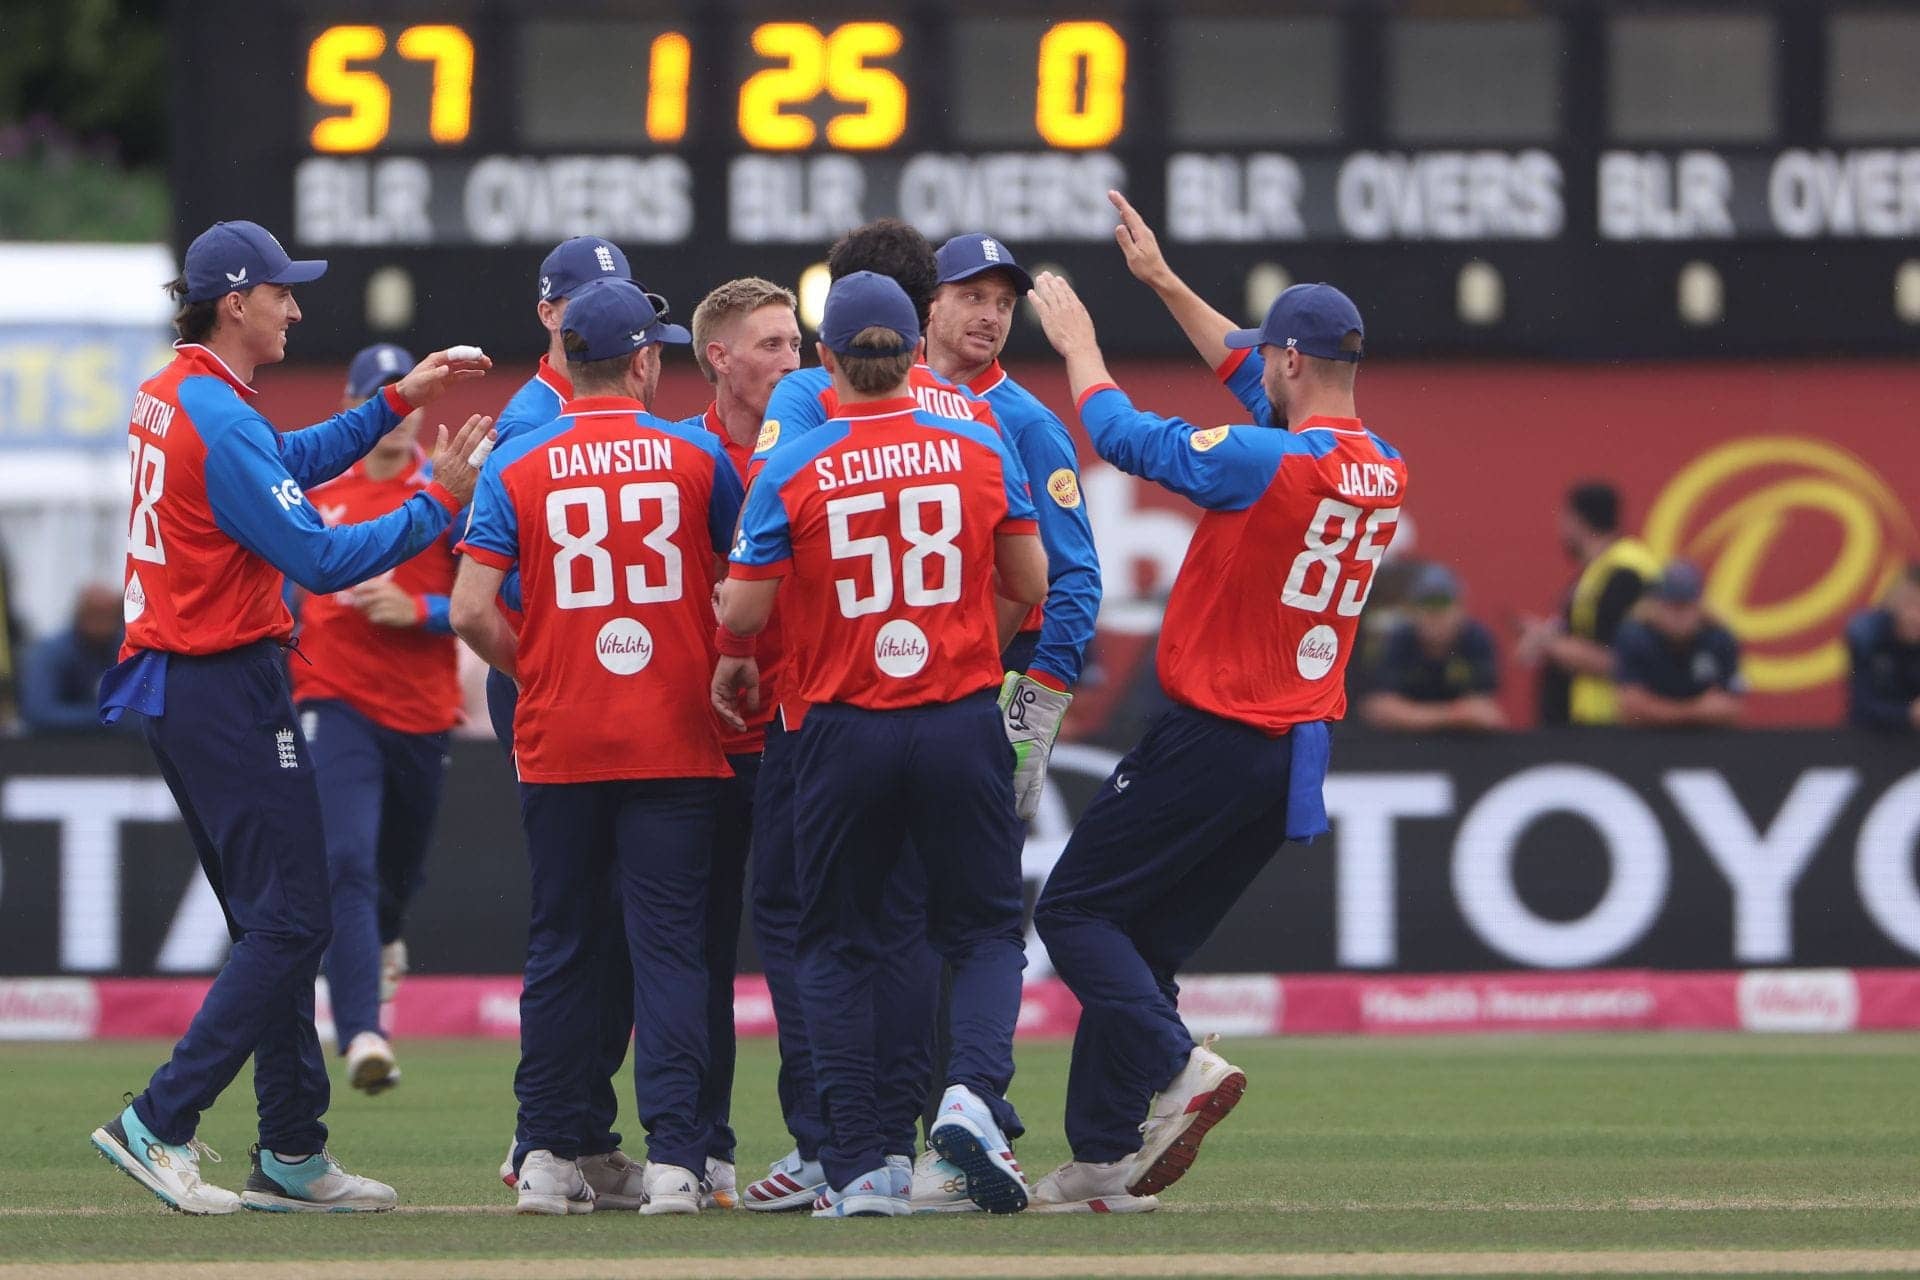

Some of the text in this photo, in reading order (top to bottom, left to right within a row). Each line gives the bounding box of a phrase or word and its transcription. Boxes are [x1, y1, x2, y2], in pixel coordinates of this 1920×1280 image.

[306, 24, 475, 152] 57
[647, 31, 692, 143] 1
[738, 21, 908, 151] 25
[1036, 21, 1127, 149] 0
[294, 153, 693, 247] BLR OVERS
[728, 150, 1128, 242] BLR OVERS
[1166, 148, 1566, 242] BLR OVERS
[1599, 149, 1735, 240] BLR
[548, 438, 673, 480] DAWSON
[815, 438, 962, 491] S.CURRAN
[1338, 462, 1398, 497] JACKS
[546, 481, 683, 610] 83
[826, 483, 963, 619] 58
[1281, 497, 1400, 617] 85
[599, 634, 651, 661] Vitality
[876, 634, 926, 662] Vitality
[1298, 637, 1335, 667] Vitality
